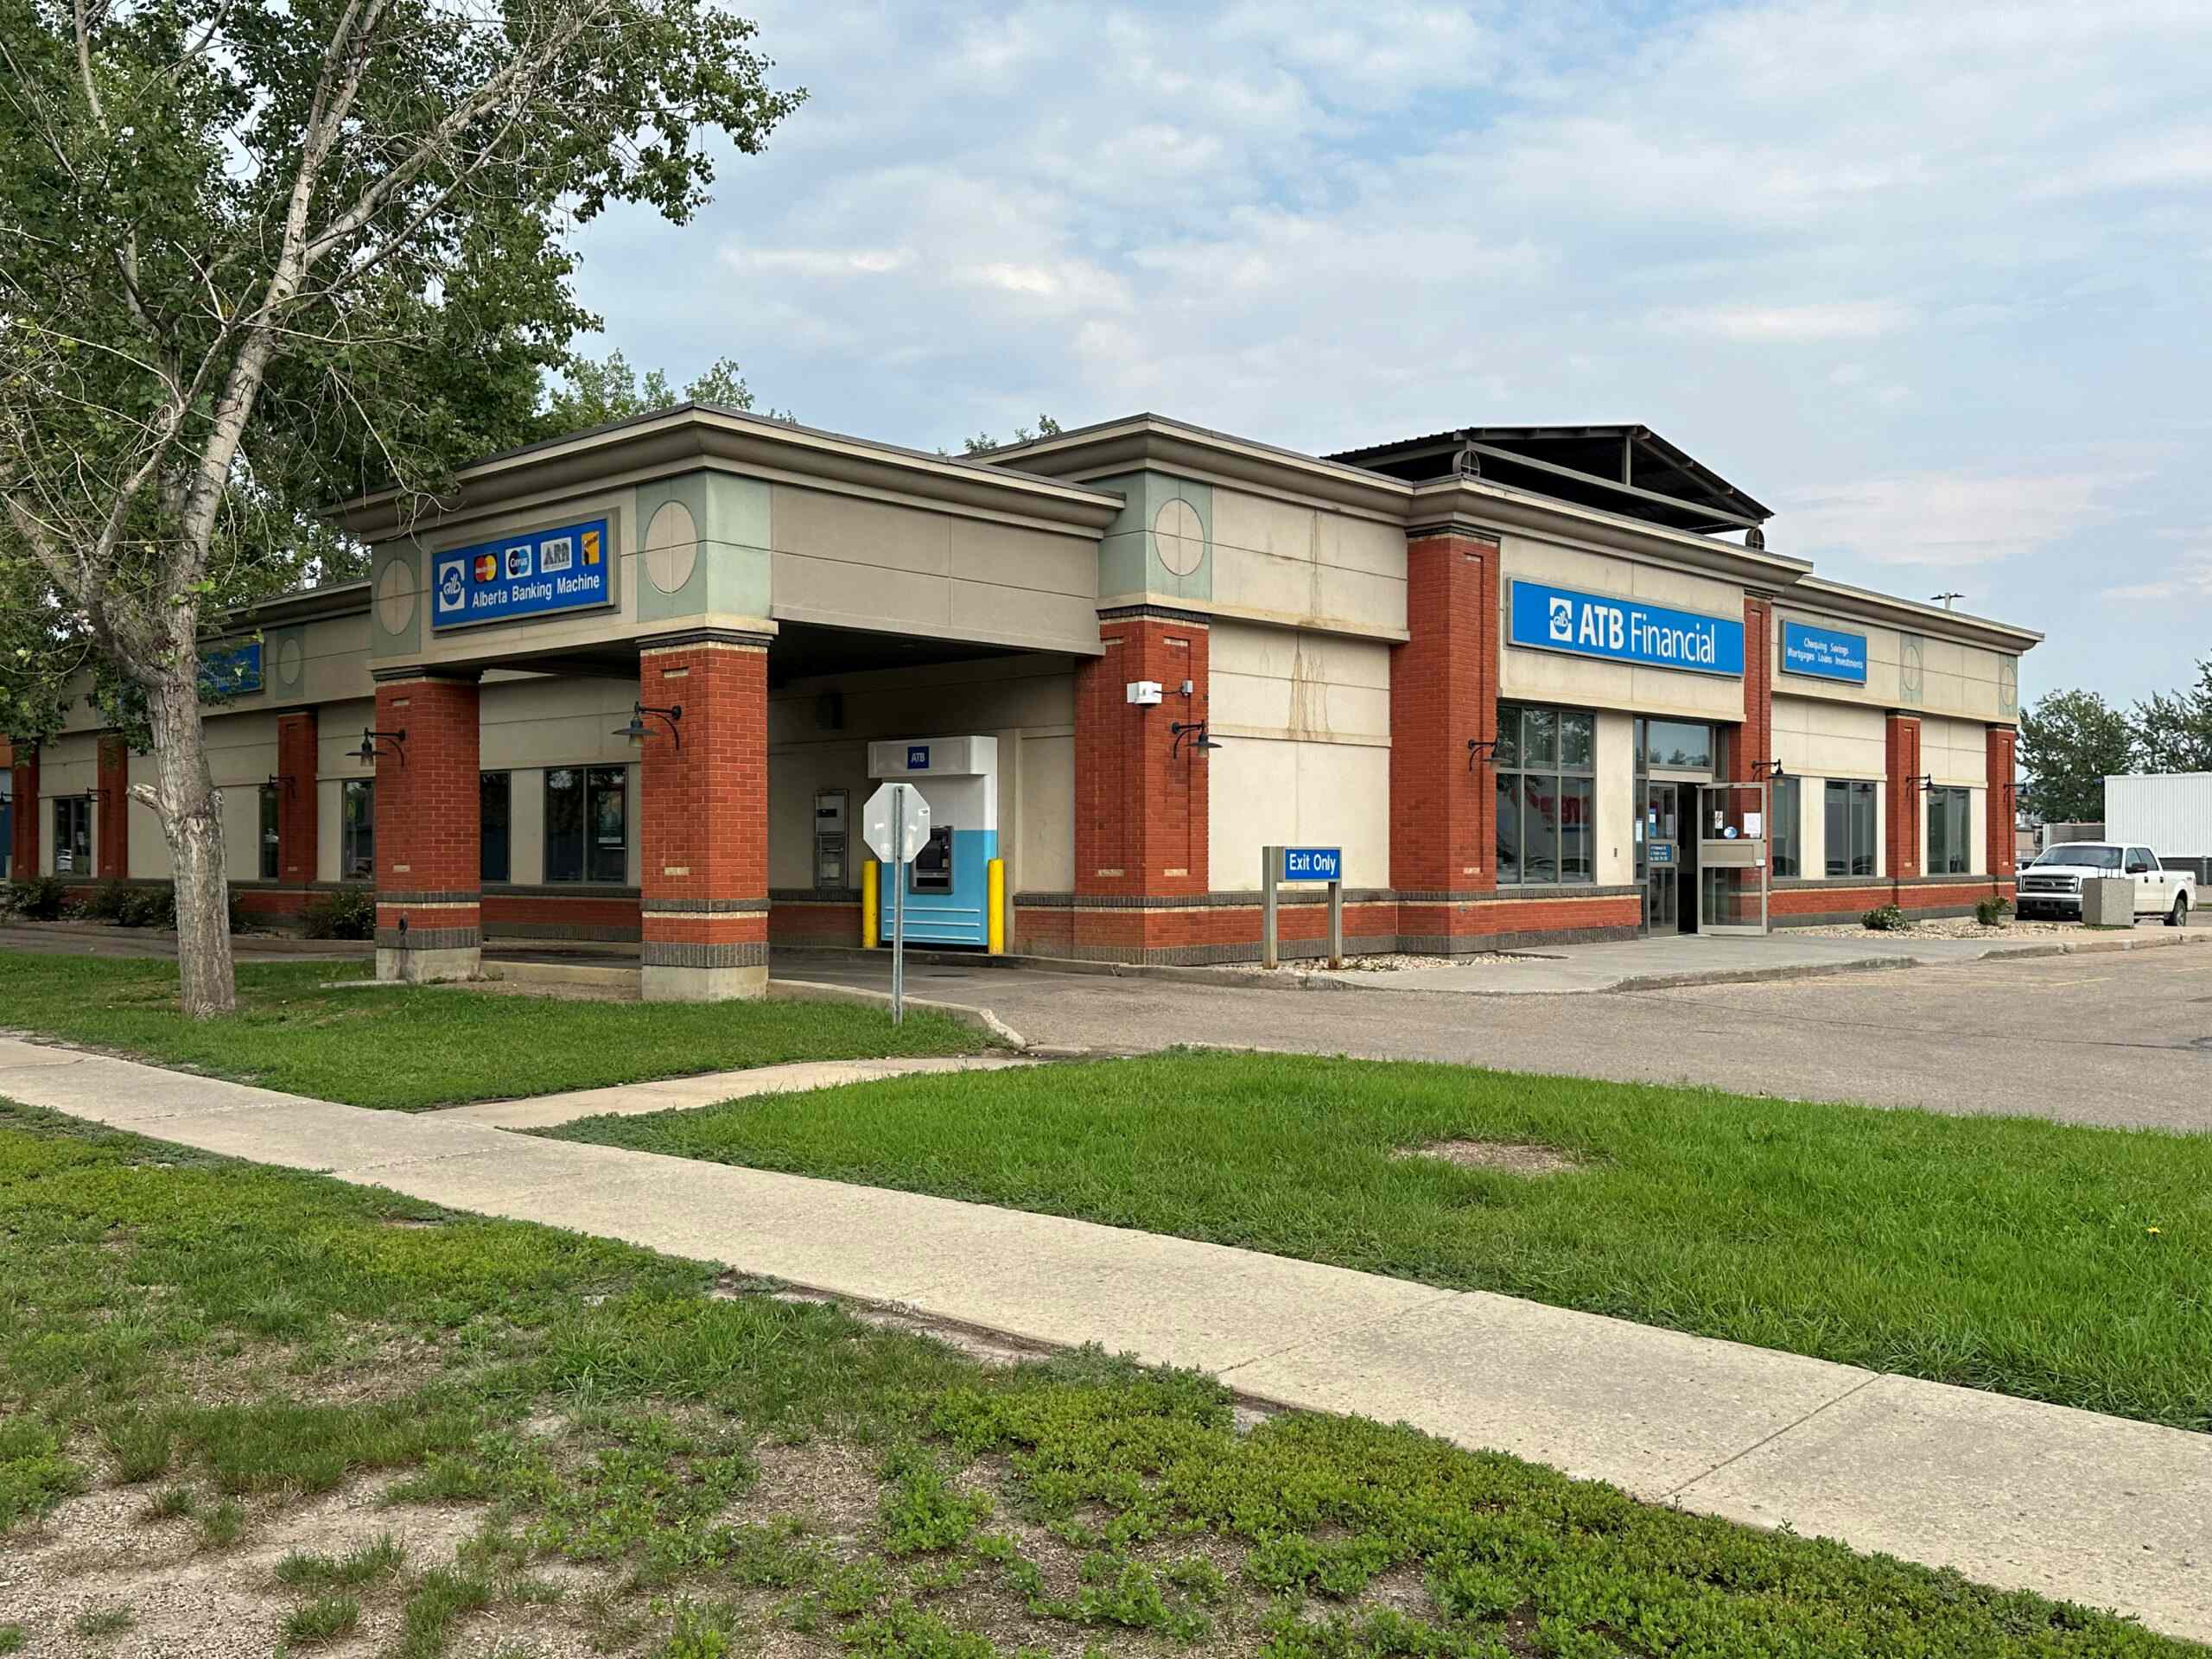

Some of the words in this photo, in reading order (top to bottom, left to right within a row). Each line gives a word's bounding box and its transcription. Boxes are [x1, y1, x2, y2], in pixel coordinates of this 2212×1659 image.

[473, 589, 507, 608] Alberta
[512, 581, 552, 602] Banking
[556, 574, 600, 594] Machine
[1579, 603, 1624, 650] ATB
[1630, 611, 1715, 664] Financial
[912, 752, 925, 763] ATB
[1289, 853, 1310, 871] Exit
[1313, 853, 1336, 875] Only
